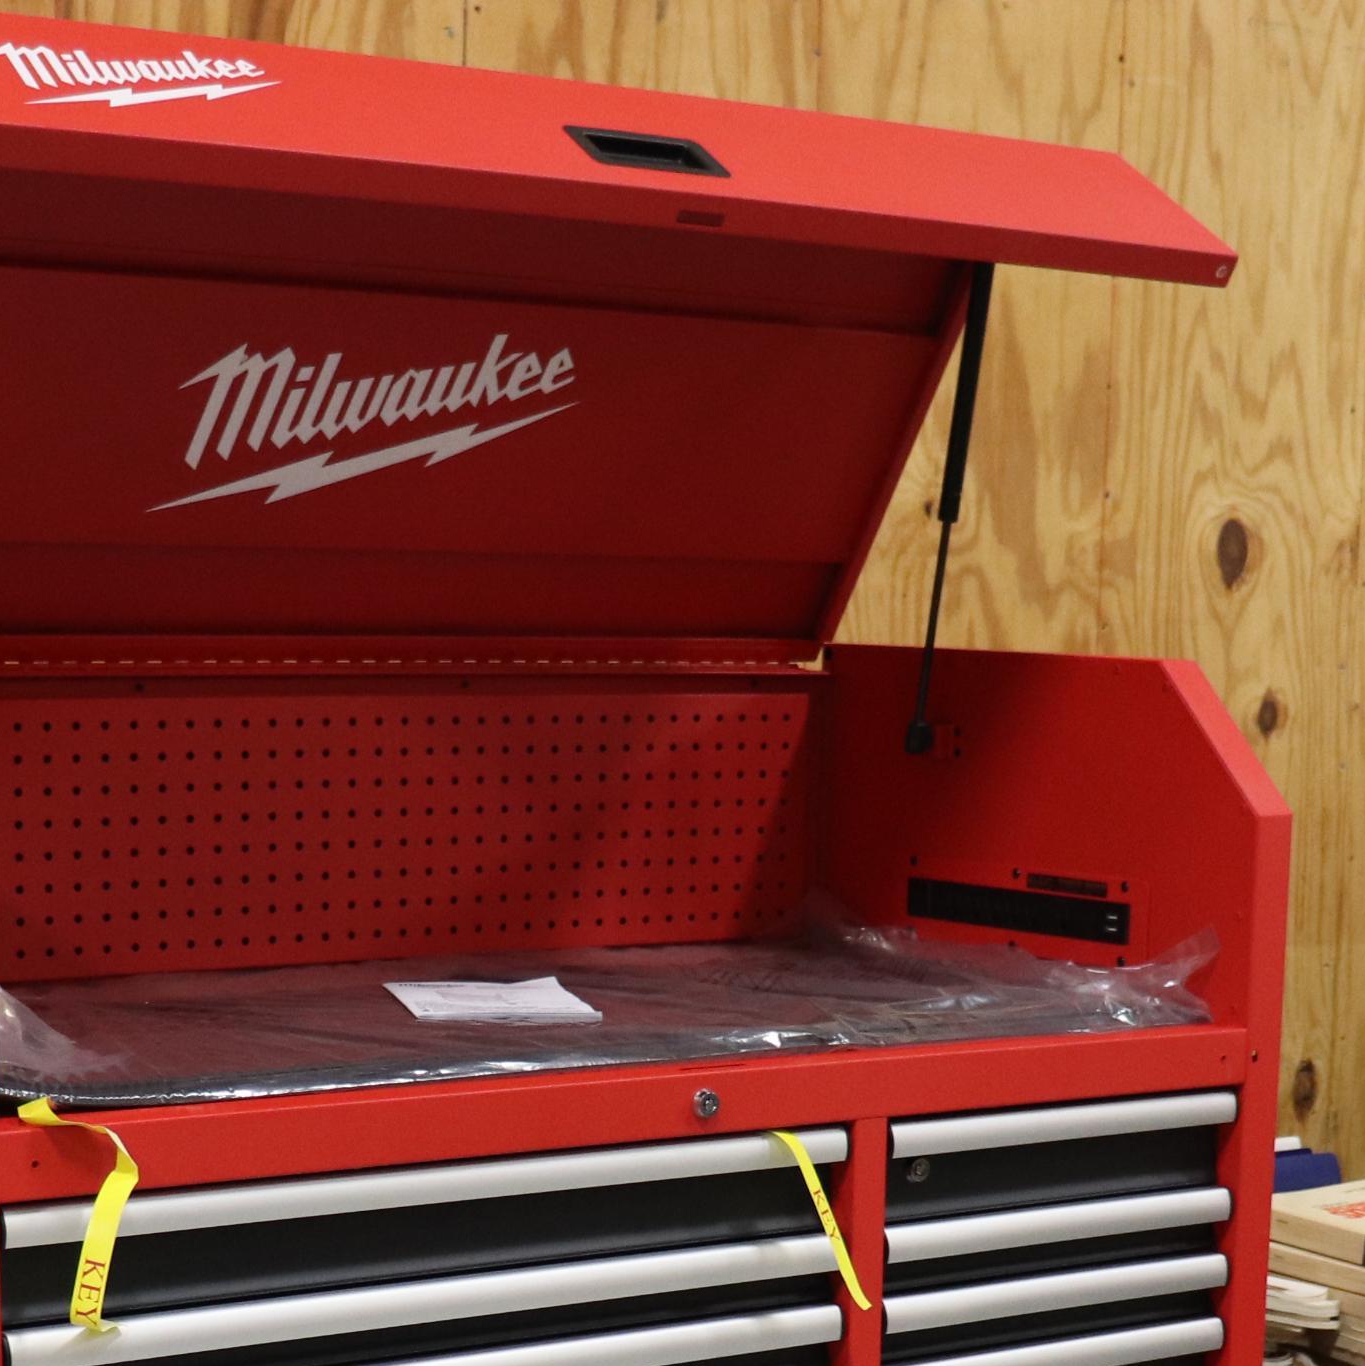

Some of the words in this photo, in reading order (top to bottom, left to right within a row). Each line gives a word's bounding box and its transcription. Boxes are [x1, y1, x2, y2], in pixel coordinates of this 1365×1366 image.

[179, 334, 576, 470] Milwaukee
[812, 1189, 841, 1241] KEY
[75, 1259, 107, 1328] KEY
